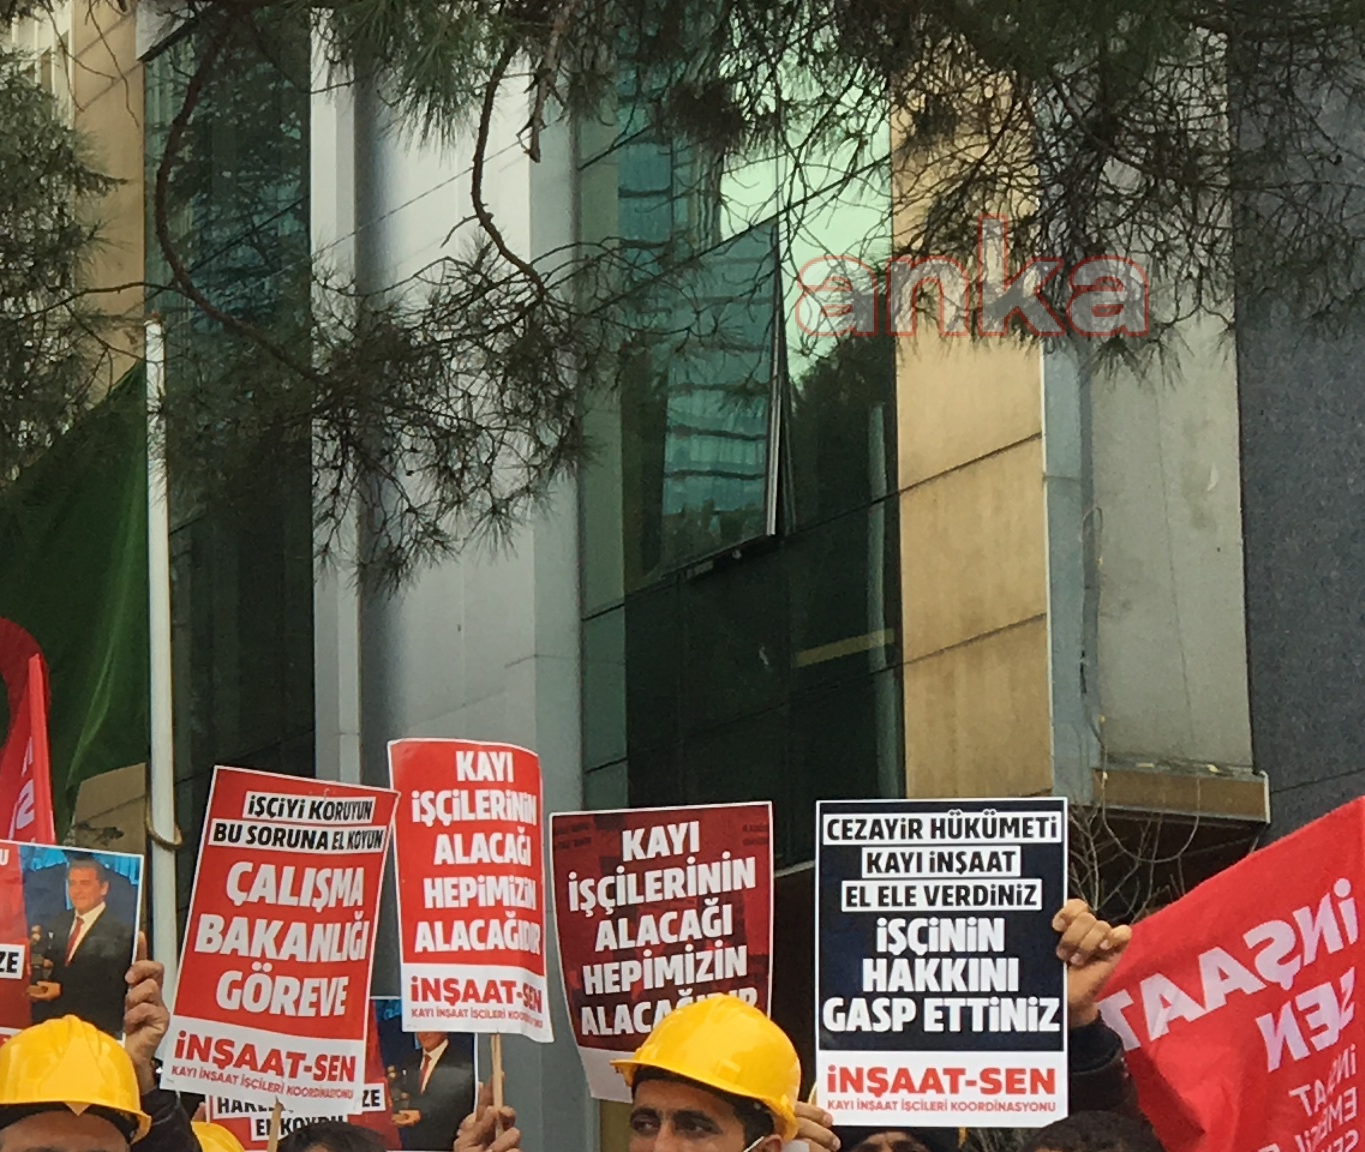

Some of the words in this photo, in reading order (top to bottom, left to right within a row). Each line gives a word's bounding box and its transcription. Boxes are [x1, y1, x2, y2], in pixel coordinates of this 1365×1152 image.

[456, 751, 514, 783] KAYI
[309, 798, 372, 820] KORUYUN
[214, 822, 242, 844] BU
[246, 825, 328, 850] SORUNA
[332, 832, 344, 850] EL
[347, 830, 384, 849] KOYUN
[433, 826, 531, 867] ALACAĞI
[622, 821, 700, 862] KAYI
[867, 851, 922, 874] KAYI
[226, 861, 364, 912] ÇALIŞMA
[845, 886, 868, 907] EL
[878, 885, 916, 907] ELE
[195, 911, 369, 962] BAKANLIĞI
[414, 910, 541, 955] ALACAĞIDIR
[595, 897, 733, 953] ALACAĞI
[216, 963, 349, 1017] GÖREVE
[863, 958, 1019, 993] HAKKINI
[822, 997, 916, 1032] GASP
[827, 1101, 854, 1111] KAYI
